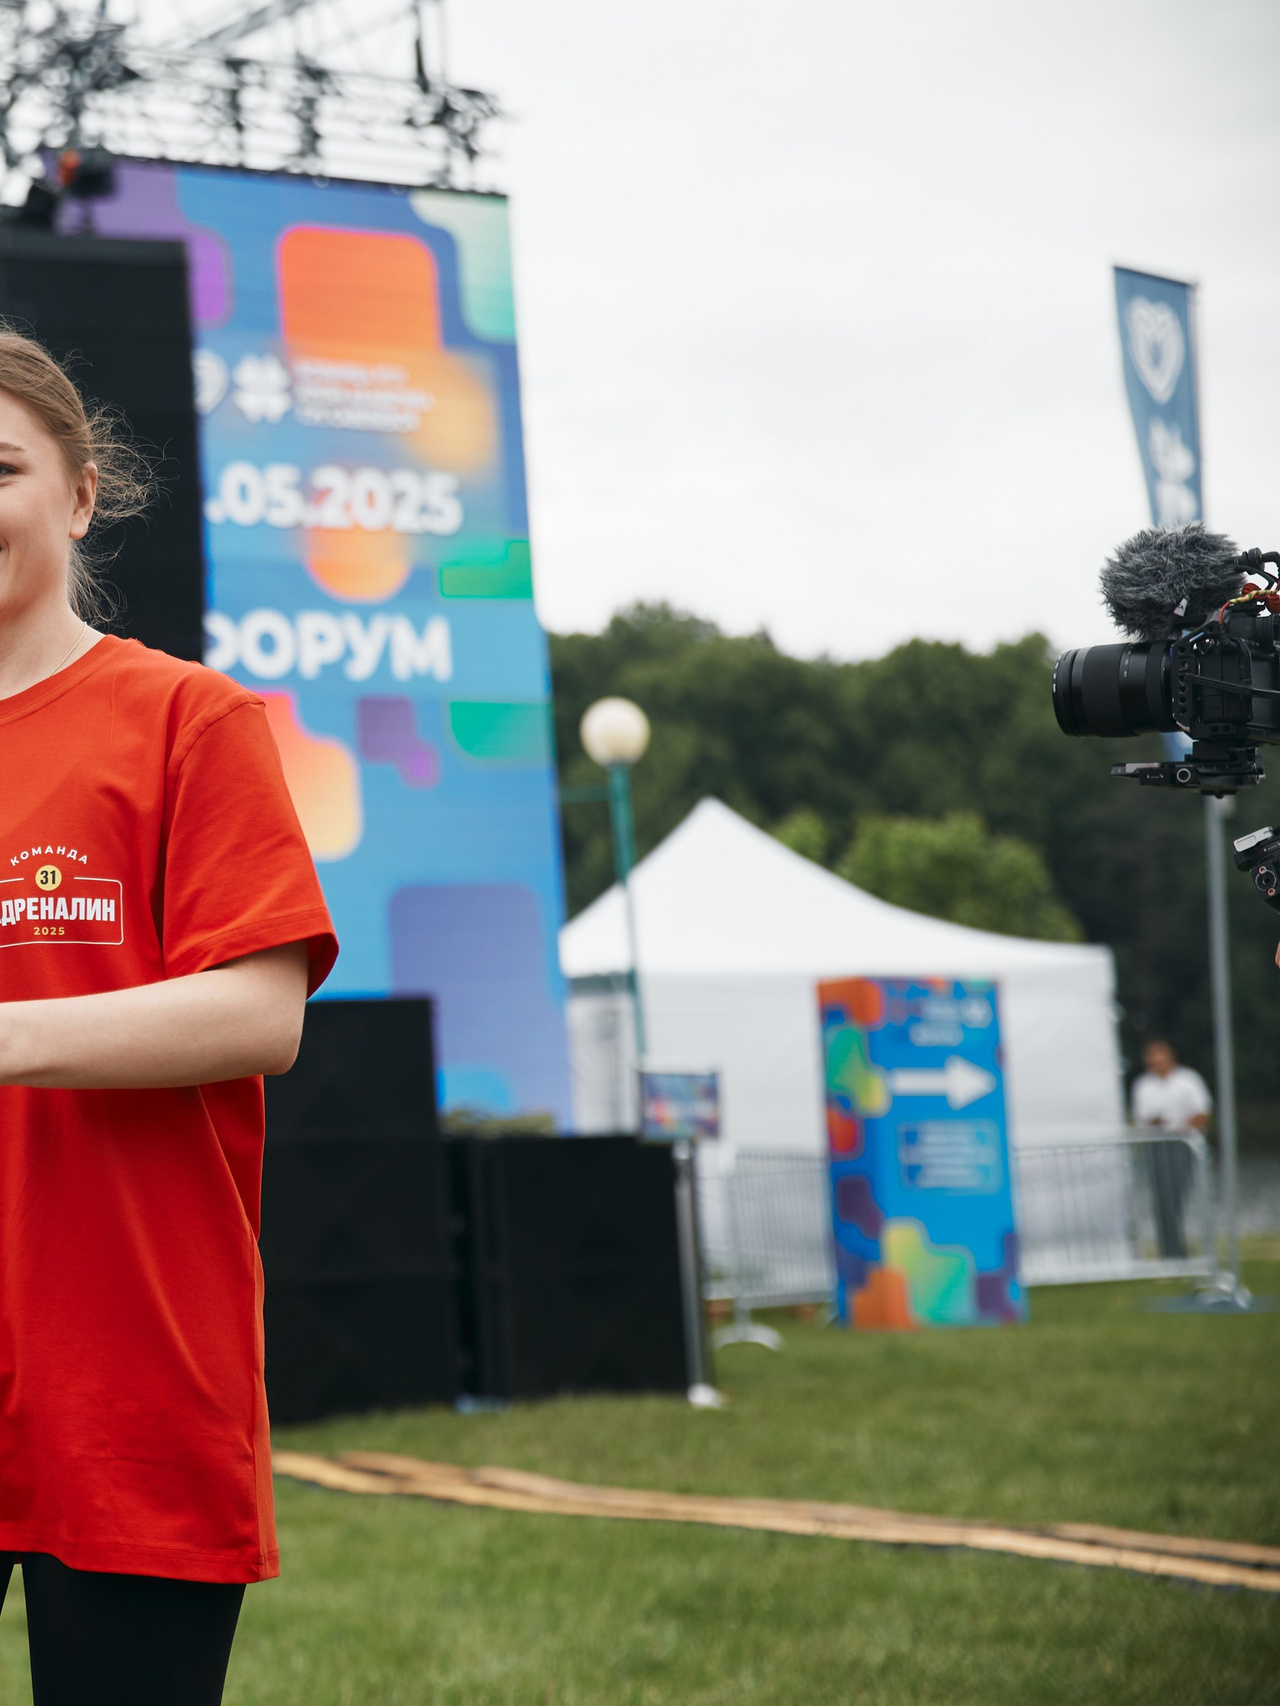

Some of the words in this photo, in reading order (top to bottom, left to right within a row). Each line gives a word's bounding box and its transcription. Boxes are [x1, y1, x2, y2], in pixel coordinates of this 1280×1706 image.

[10, 845, 89, 867] КОМАНДА
[39, 869, 58, 886] 31
[33, 926, 66, 936] 2025
